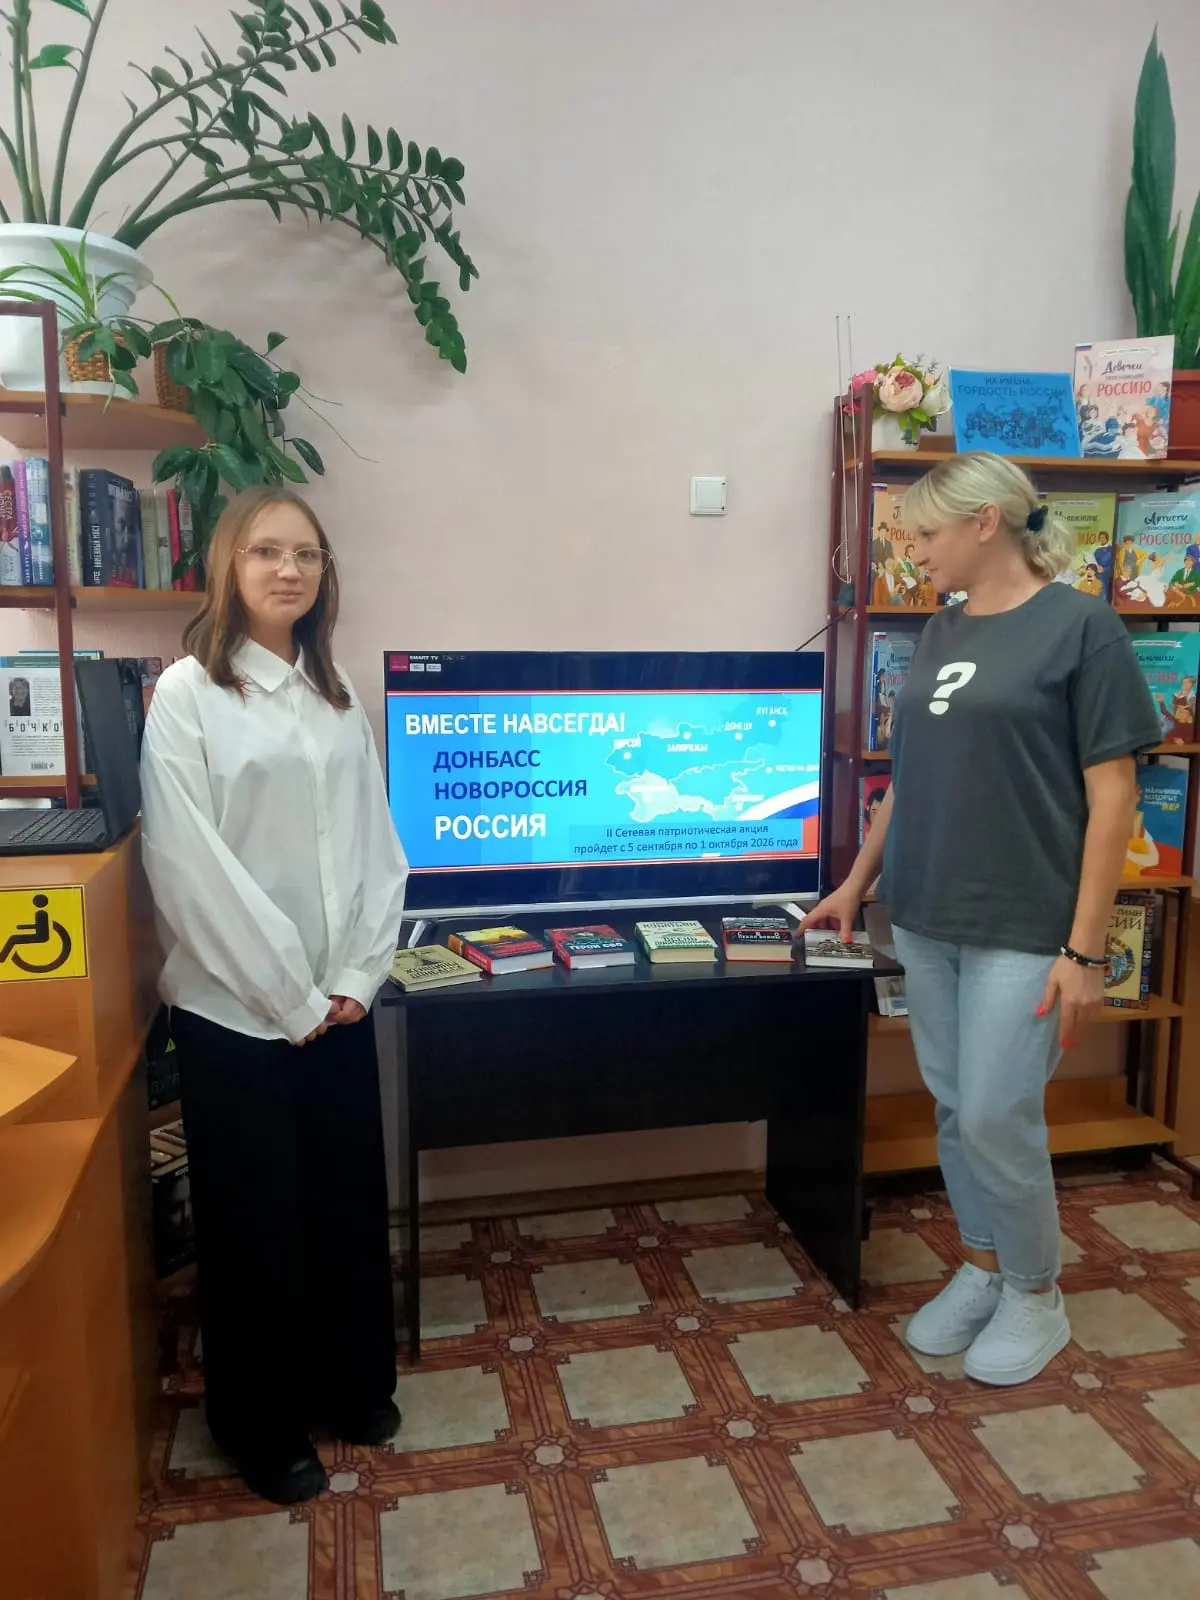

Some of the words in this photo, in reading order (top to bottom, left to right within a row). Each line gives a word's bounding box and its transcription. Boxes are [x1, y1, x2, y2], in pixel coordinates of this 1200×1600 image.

[1097, 380, 1152, 397] РОССИЮ
[1138, 532, 1192, 545] РОССИЮ
[8, 722, 60, 732] БОЧКО
[405, 713, 497, 736] ВМЕСТЕ
[503, 712, 626, 737] НАВСЕГДА!
[433, 749, 541, 773] ДОНБАСС
[434, 779, 588, 800] НОВОРОССИЯ
[434, 813, 547, 840] РОССИЯ
[615, 828, 656, 838] Сетевая
[658, 826, 737, 838] патриотическая
[739, 825, 769, 836] акция
[574, 844, 619, 855] пройдет
[627, 842, 634, 852] 5
[636, 841, 683, 853] сентября
[700, 840, 706, 849] 1
[708, 839, 749, 851] октября
[750, 838, 775, 848] 2026
[776, 838, 798, 848] года
